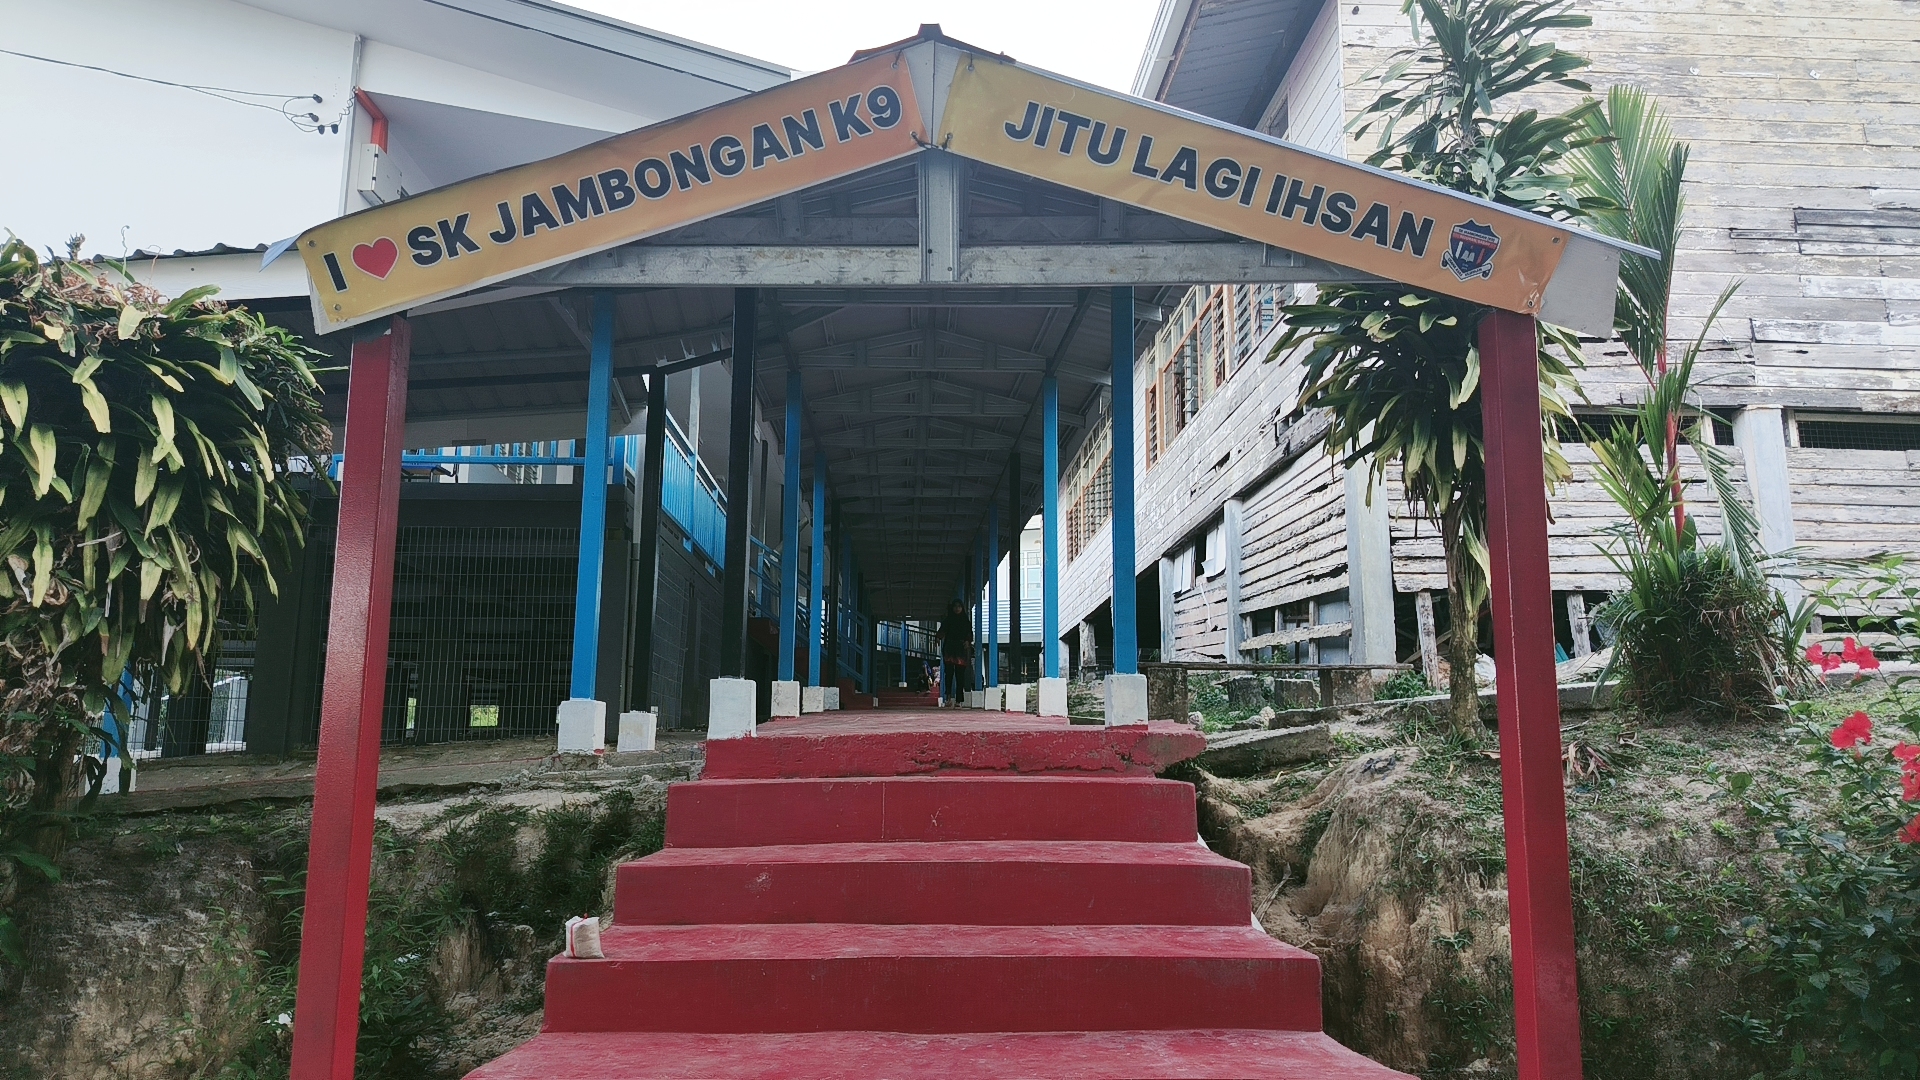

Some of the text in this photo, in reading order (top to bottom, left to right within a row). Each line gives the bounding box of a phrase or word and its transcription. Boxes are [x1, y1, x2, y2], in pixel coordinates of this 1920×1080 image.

[321, 85, 902, 291] I SK JAMBONGAN K9
[1004, 100, 1436, 258] JITU LAGI IHSAN
